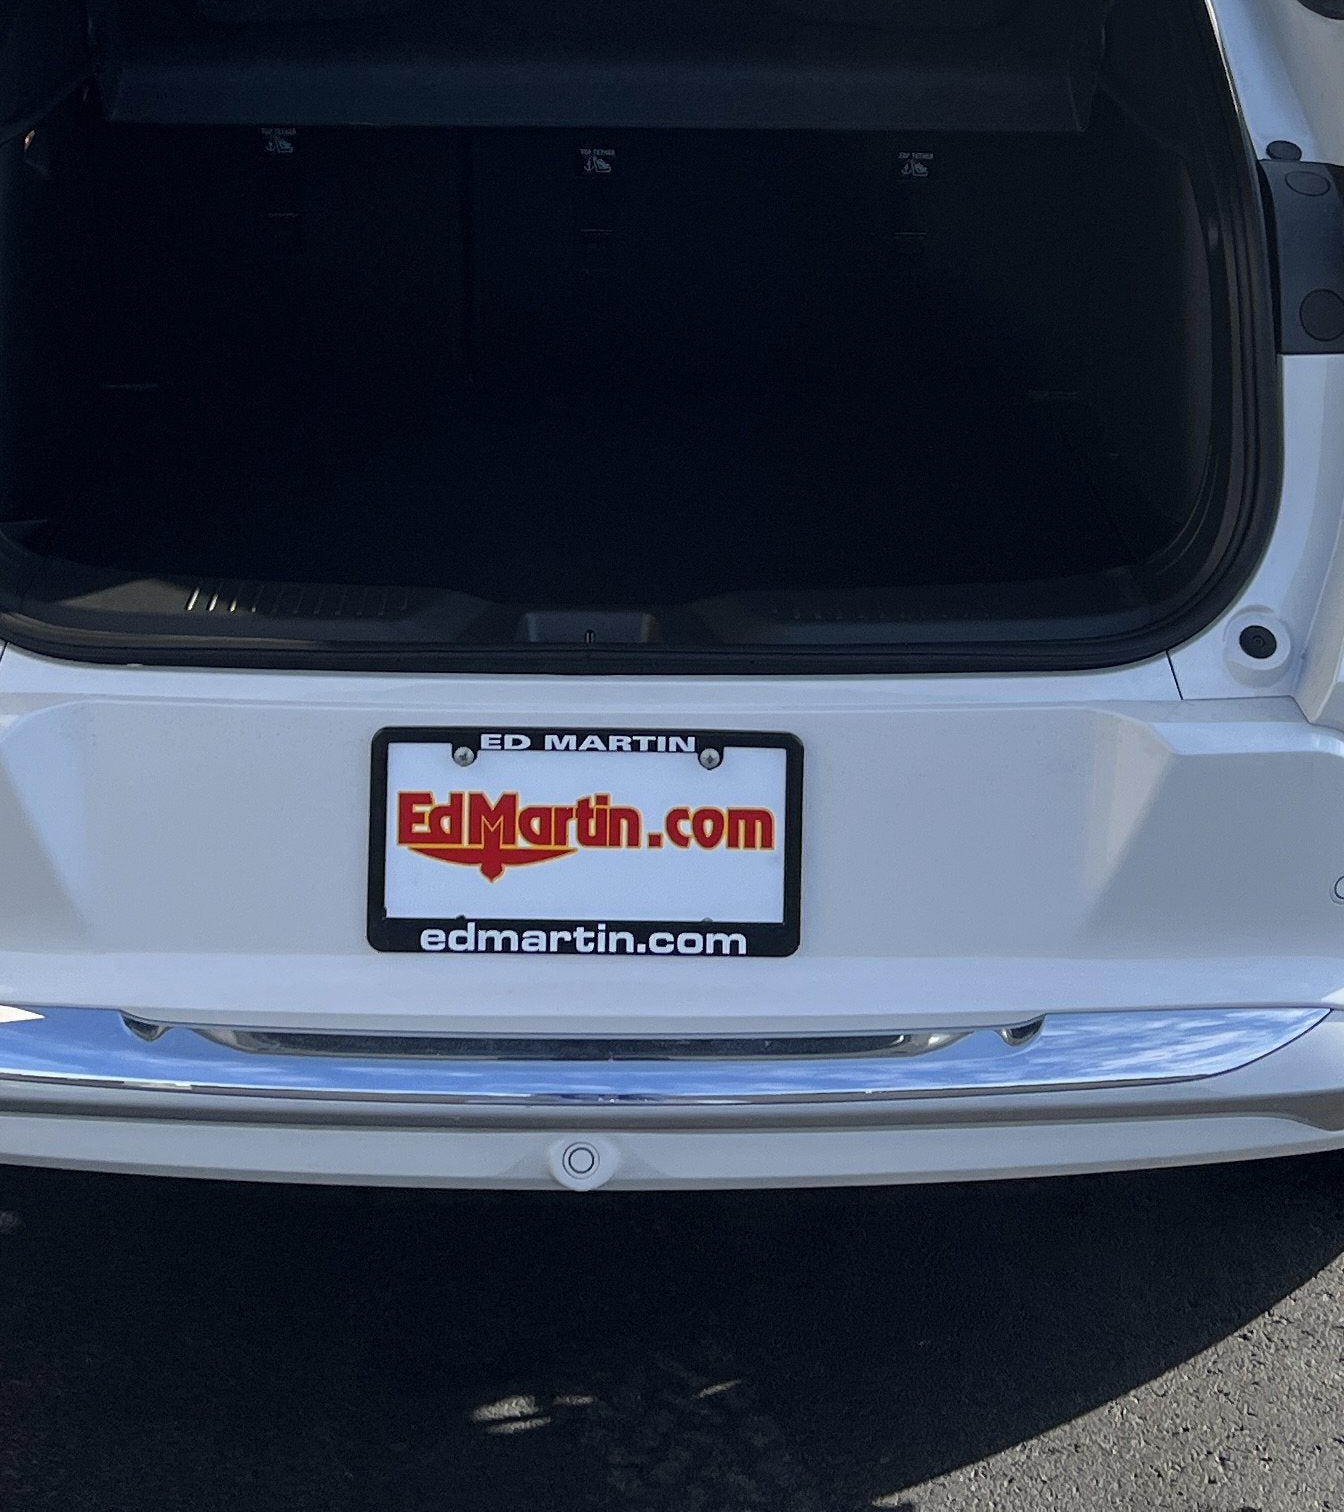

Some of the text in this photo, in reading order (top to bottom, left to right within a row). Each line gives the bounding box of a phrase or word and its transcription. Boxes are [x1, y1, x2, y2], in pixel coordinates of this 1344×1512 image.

[479, 733, 696, 752] ED MARTIN
[397, 791, 775, 881] EdMartin.com
[419, 922, 747, 955] edmartin.com
